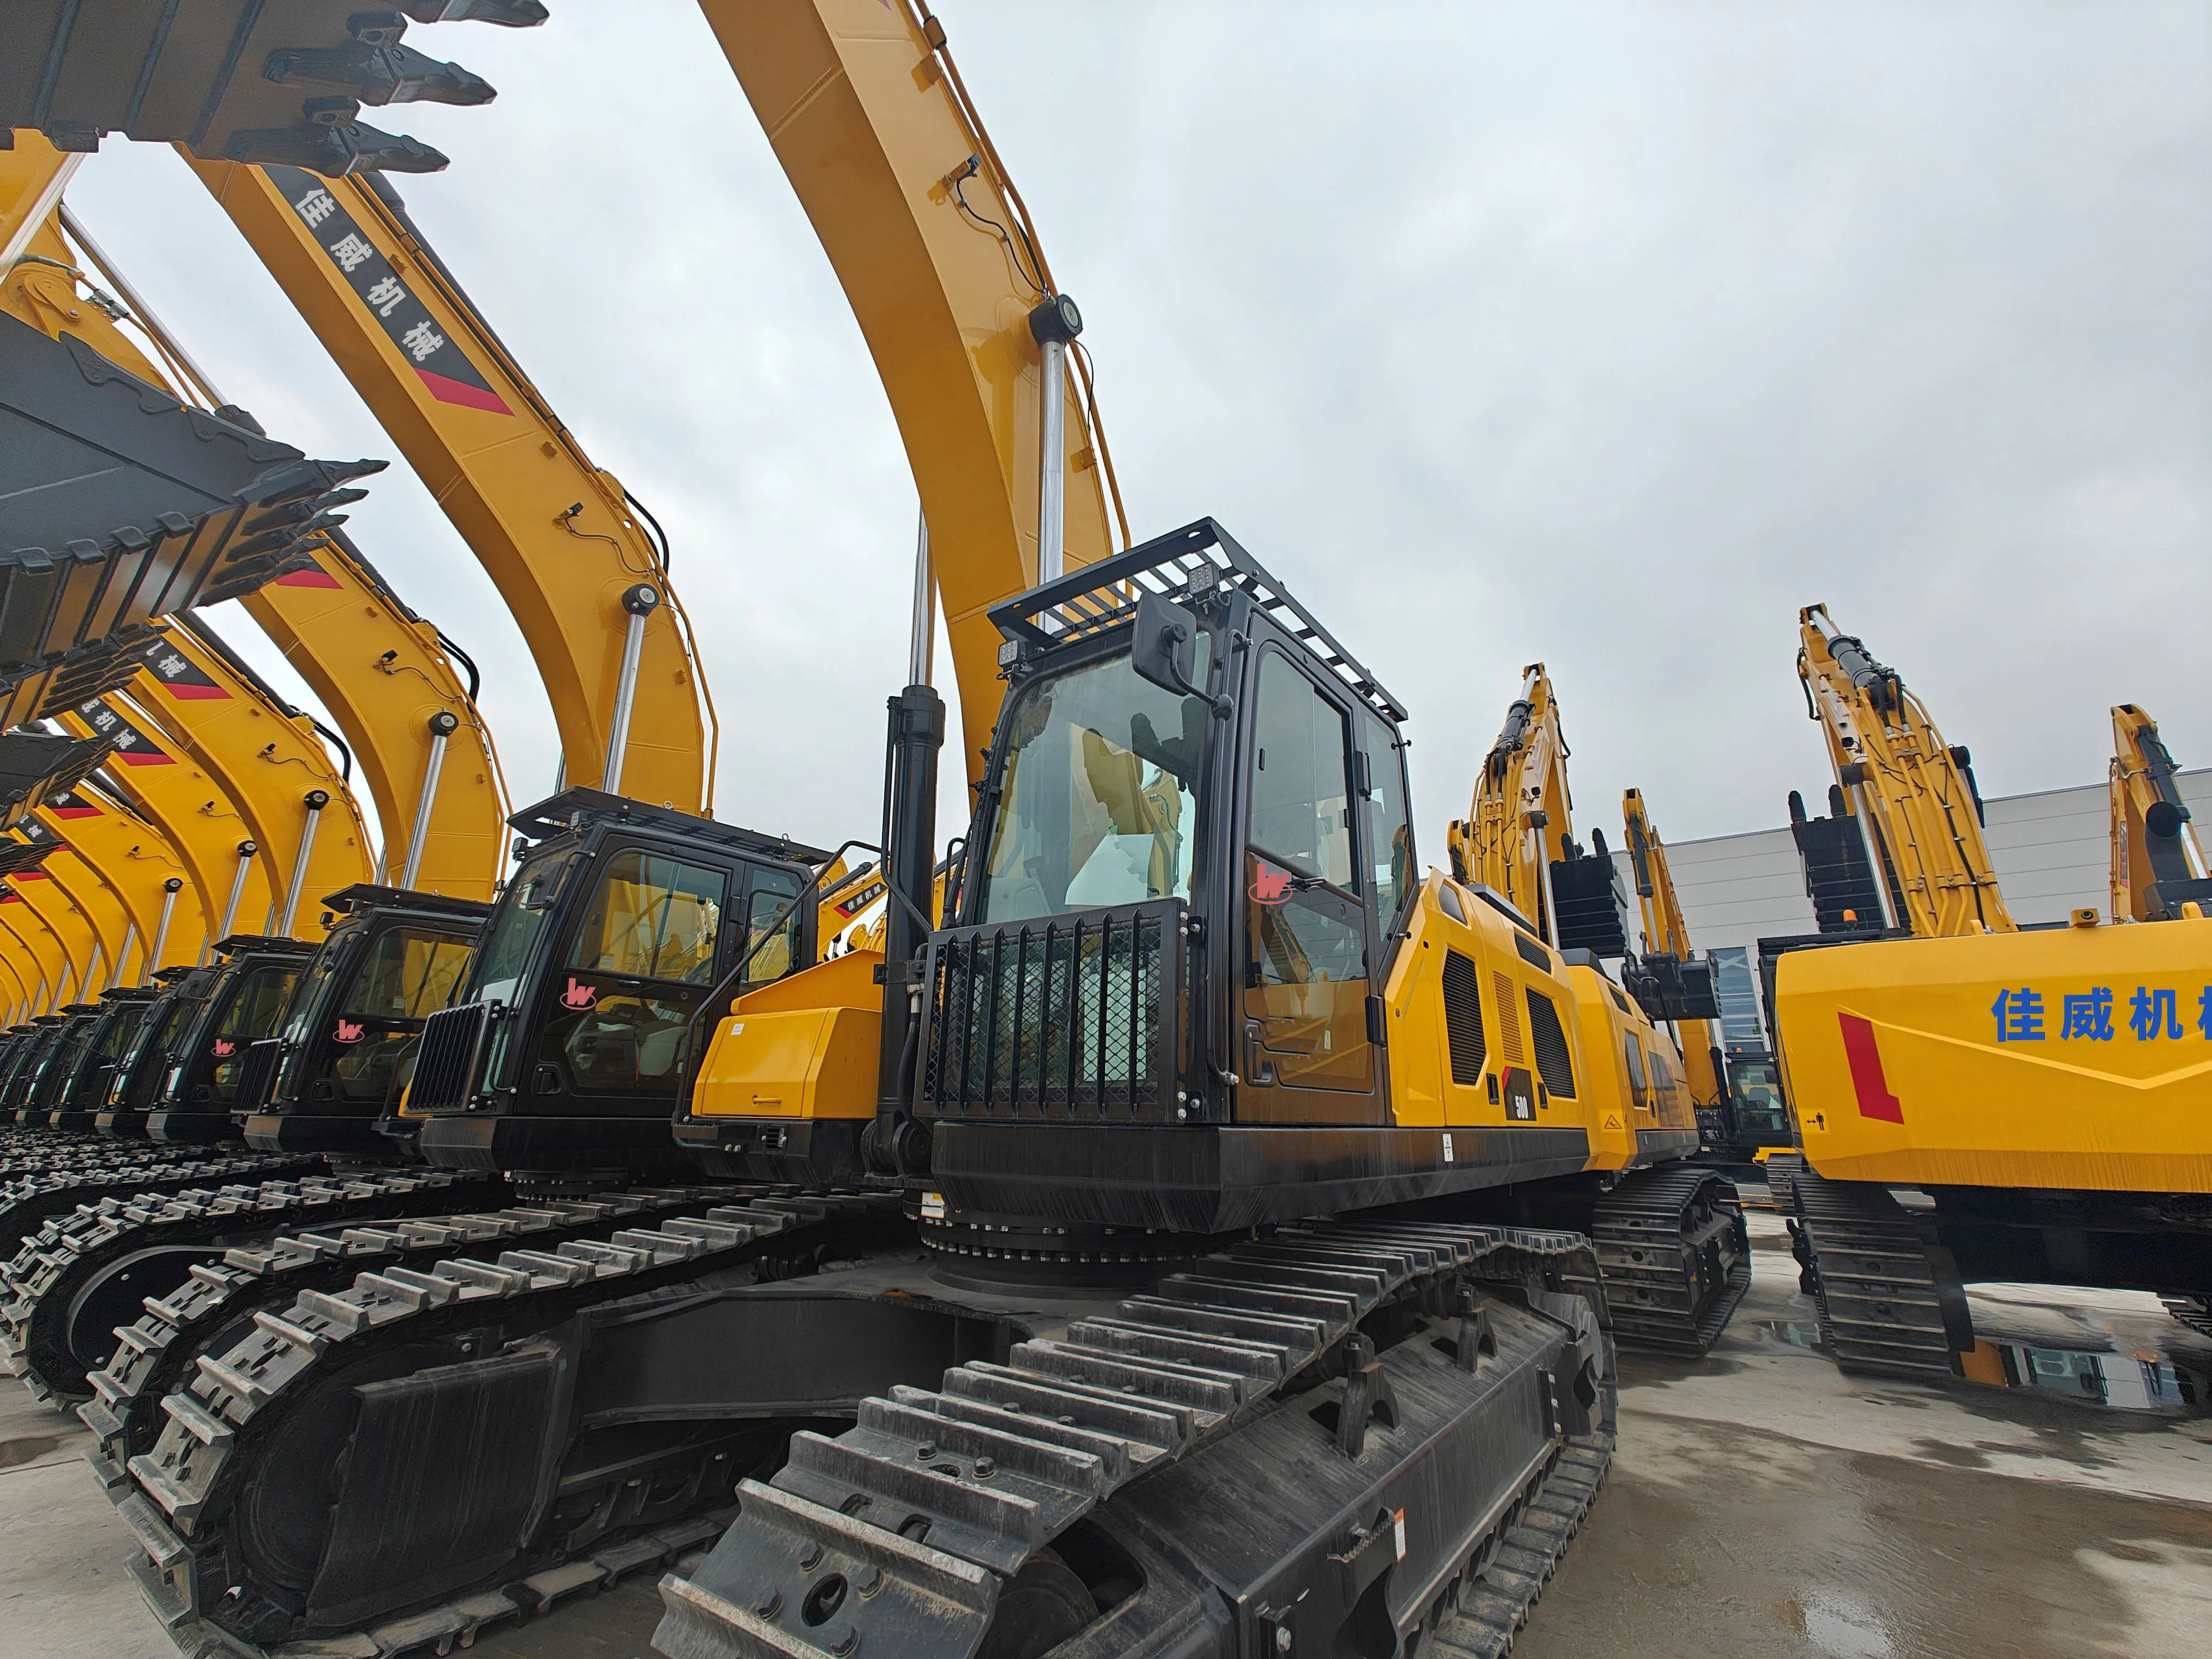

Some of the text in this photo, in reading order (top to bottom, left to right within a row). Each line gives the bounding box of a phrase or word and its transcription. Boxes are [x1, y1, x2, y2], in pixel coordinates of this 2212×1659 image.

[295, 188, 444, 361] 佳威机械
[847, 884, 881, 911] 佳威机械
[1515, 1095, 1528, 1119] 500
